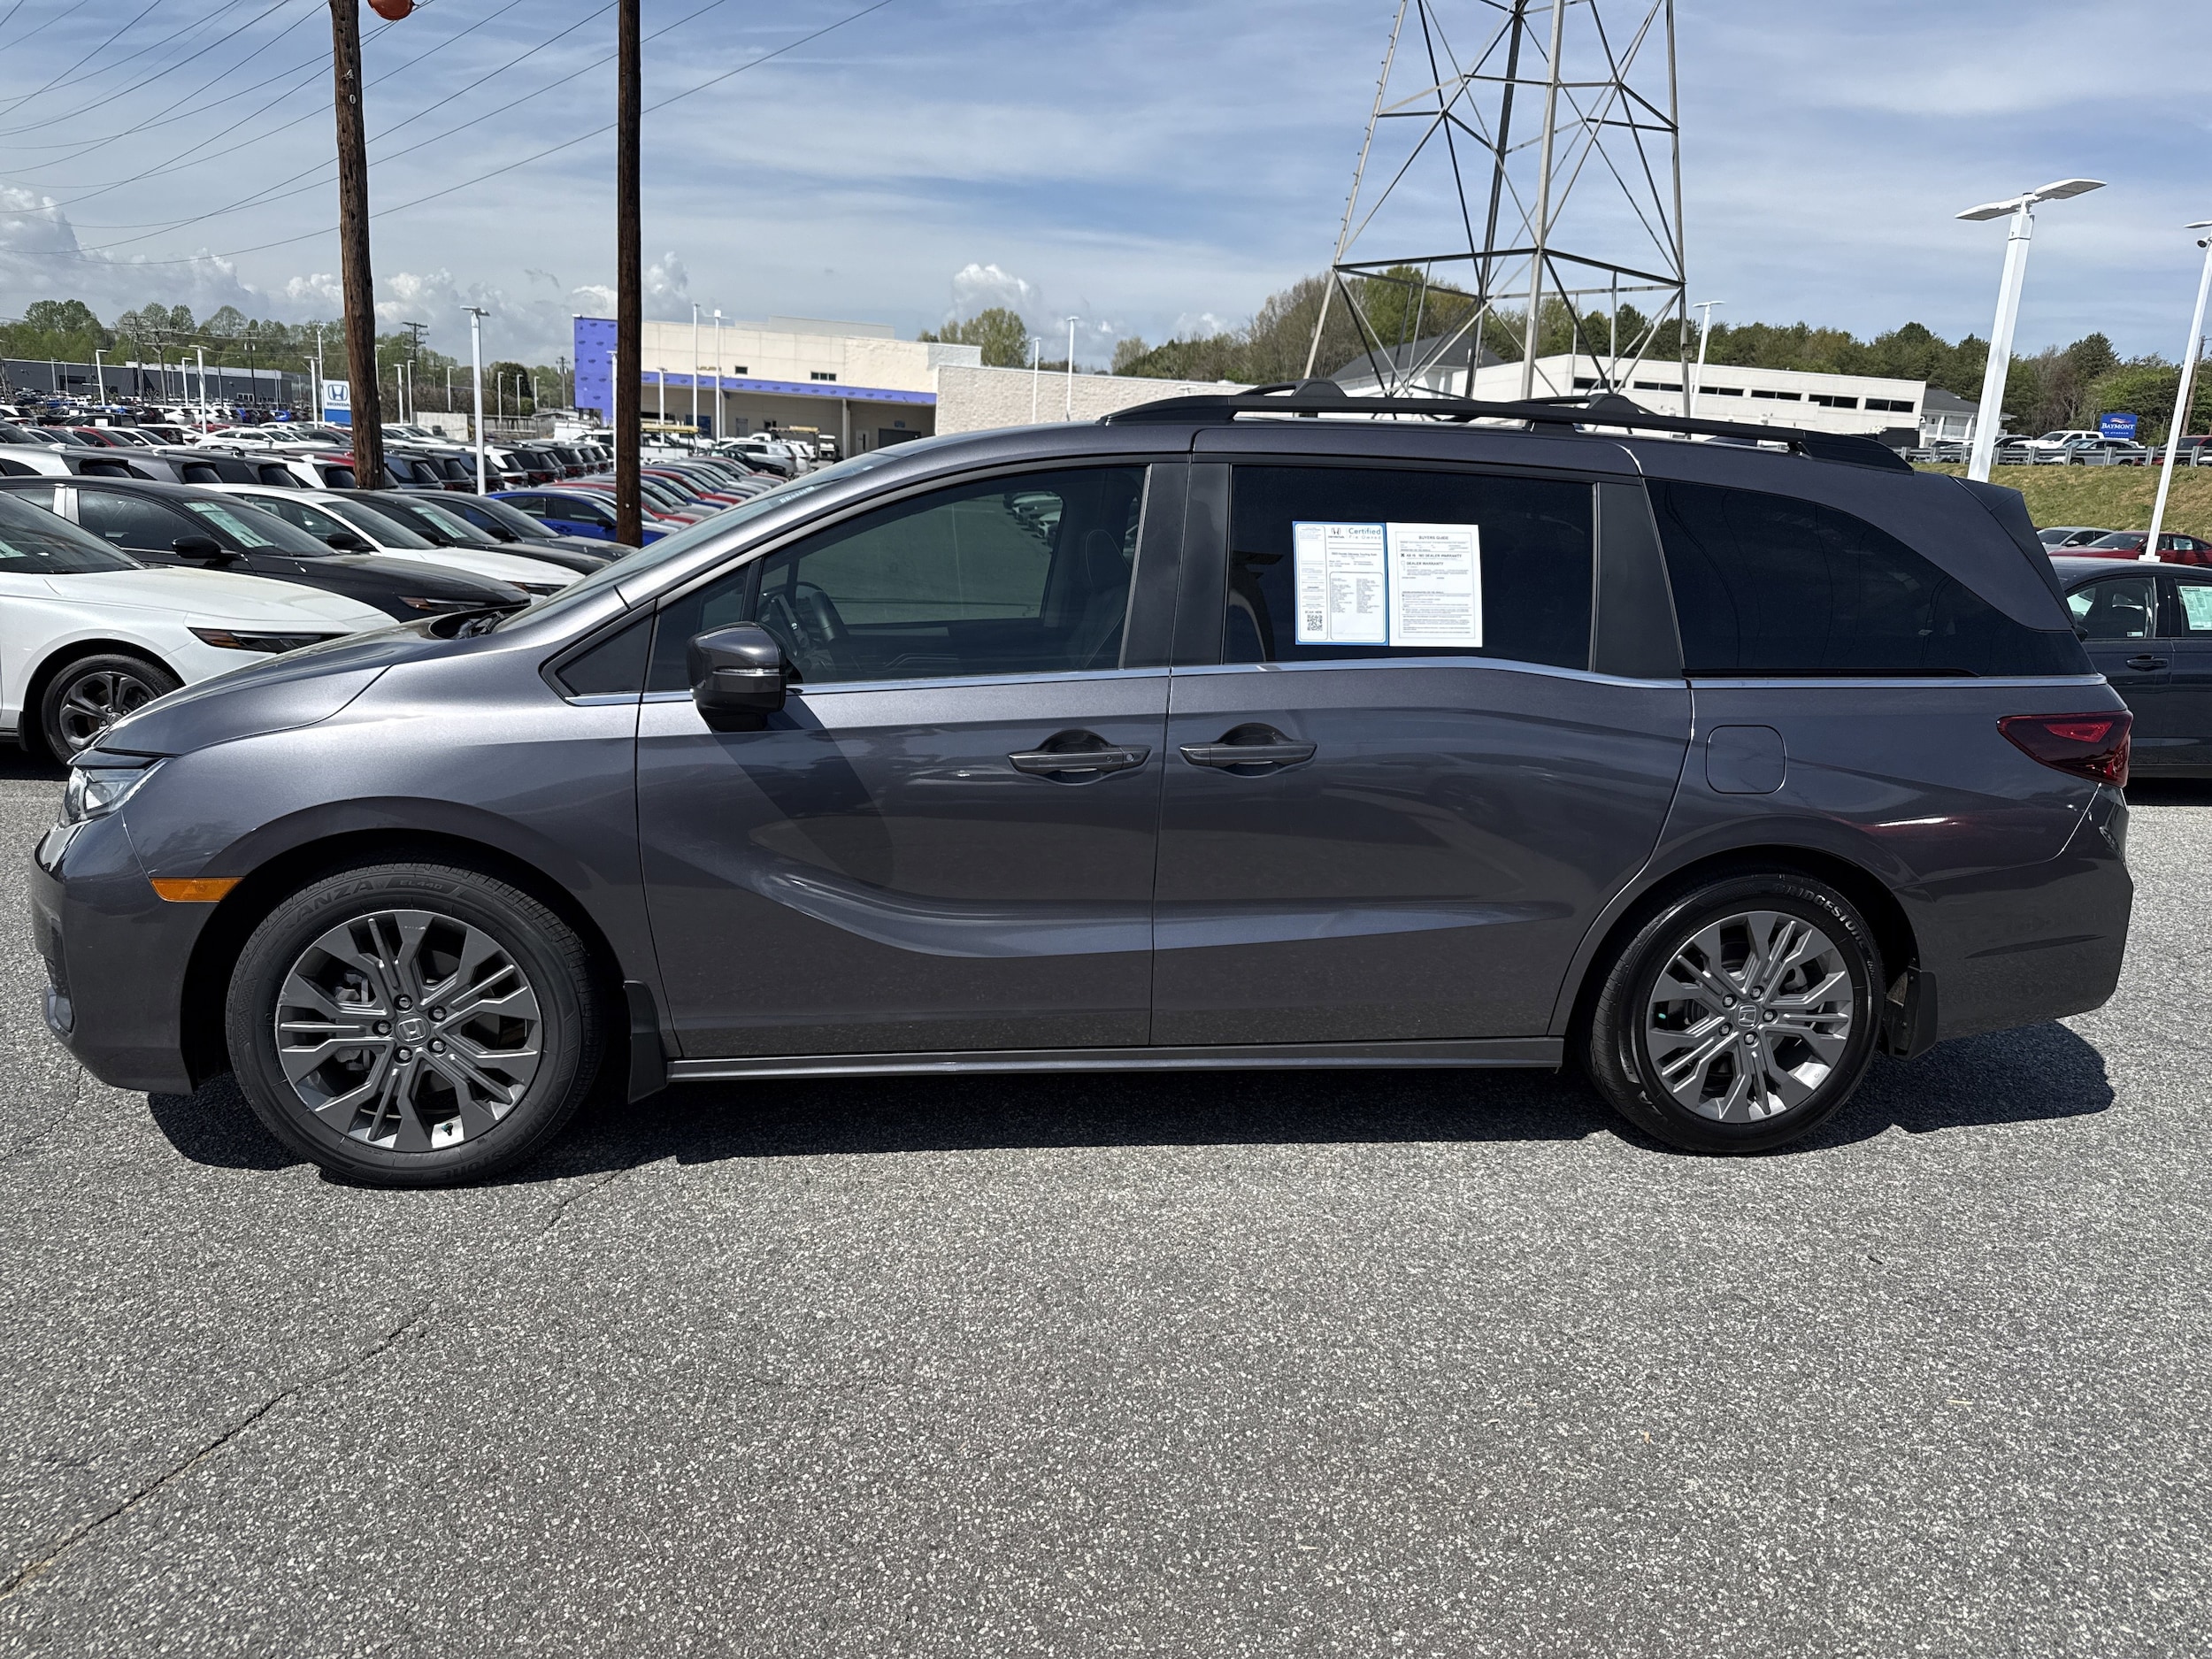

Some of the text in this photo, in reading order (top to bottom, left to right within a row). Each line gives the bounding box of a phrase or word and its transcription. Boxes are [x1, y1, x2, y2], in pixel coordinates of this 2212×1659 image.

[1348, 526, 1381, 535] Certified
[398, 879, 443, 891] EL440
[1774, 882, 1867, 950] BRIDGESTONE
